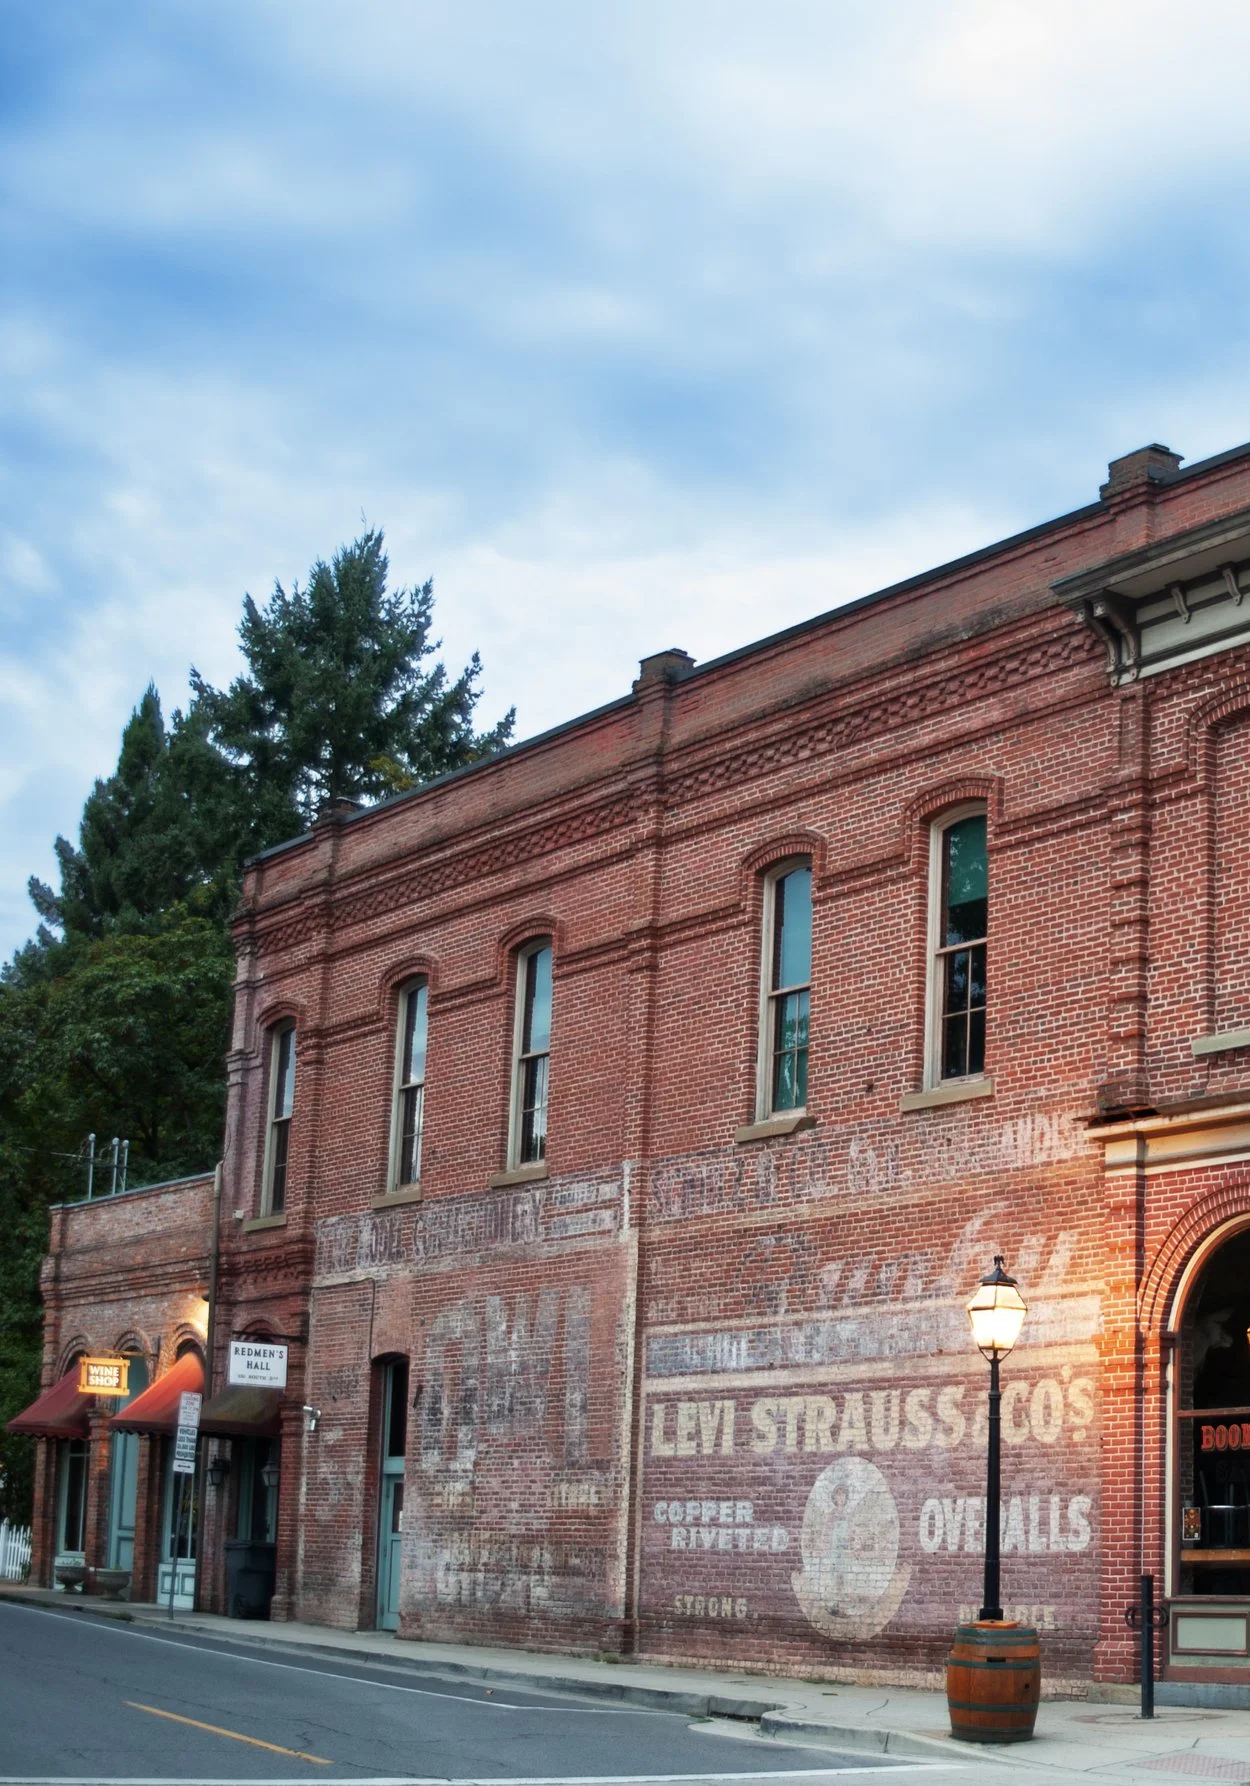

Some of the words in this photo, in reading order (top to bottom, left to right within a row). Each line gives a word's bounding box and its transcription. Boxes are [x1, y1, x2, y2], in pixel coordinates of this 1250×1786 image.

[234, 1347, 284, 1359] REDMEN'S
[88, 1365, 120, 1376] WINE
[246, 1360, 271, 1371] HALL
[88, 1375, 120, 1387] SHOP
[651, 1400, 736, 1456] LEVI
[750, 1385, 967, 1455] STRAUSS
[653, 1501, 755, 1523] COPPER
[919, 1494, 1092, 1552] OVEALLS
[671, 1524, 790, 1551] RIVETED
